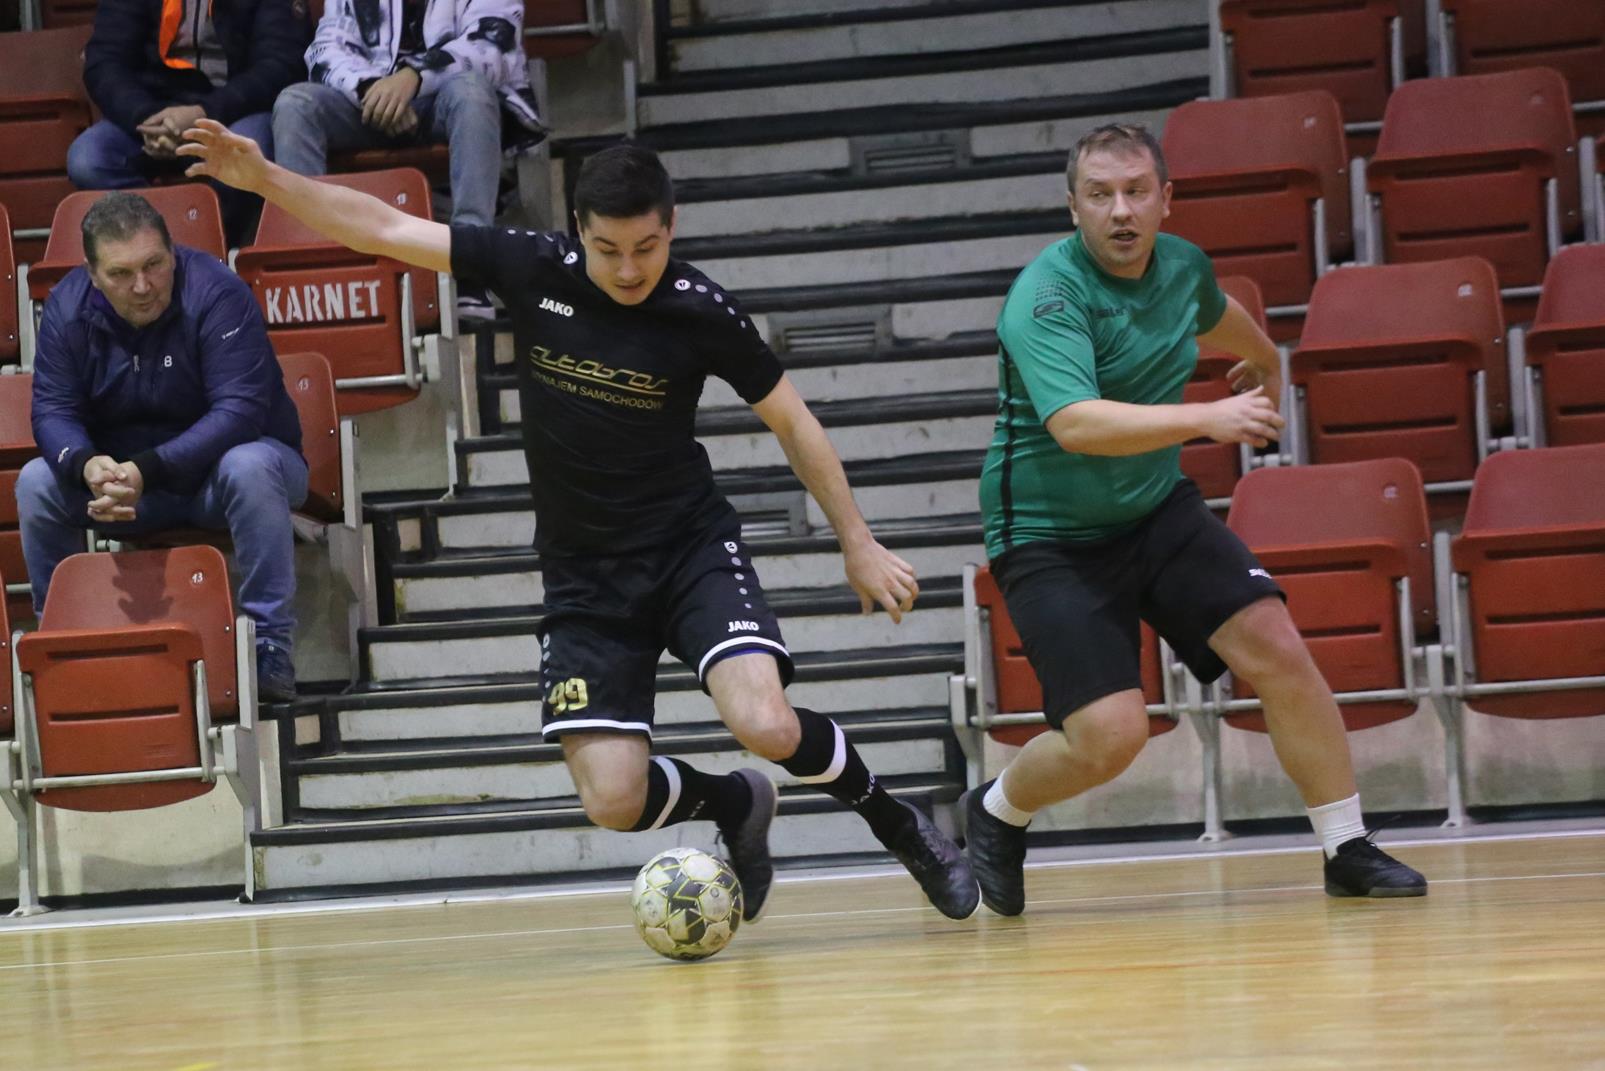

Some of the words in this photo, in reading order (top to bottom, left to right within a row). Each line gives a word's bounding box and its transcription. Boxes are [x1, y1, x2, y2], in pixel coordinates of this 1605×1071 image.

[265, 280, 381, 324] KARNET
[538, 297, 574, 317] JAKO
[728, 620, 759, 632] JAKO
